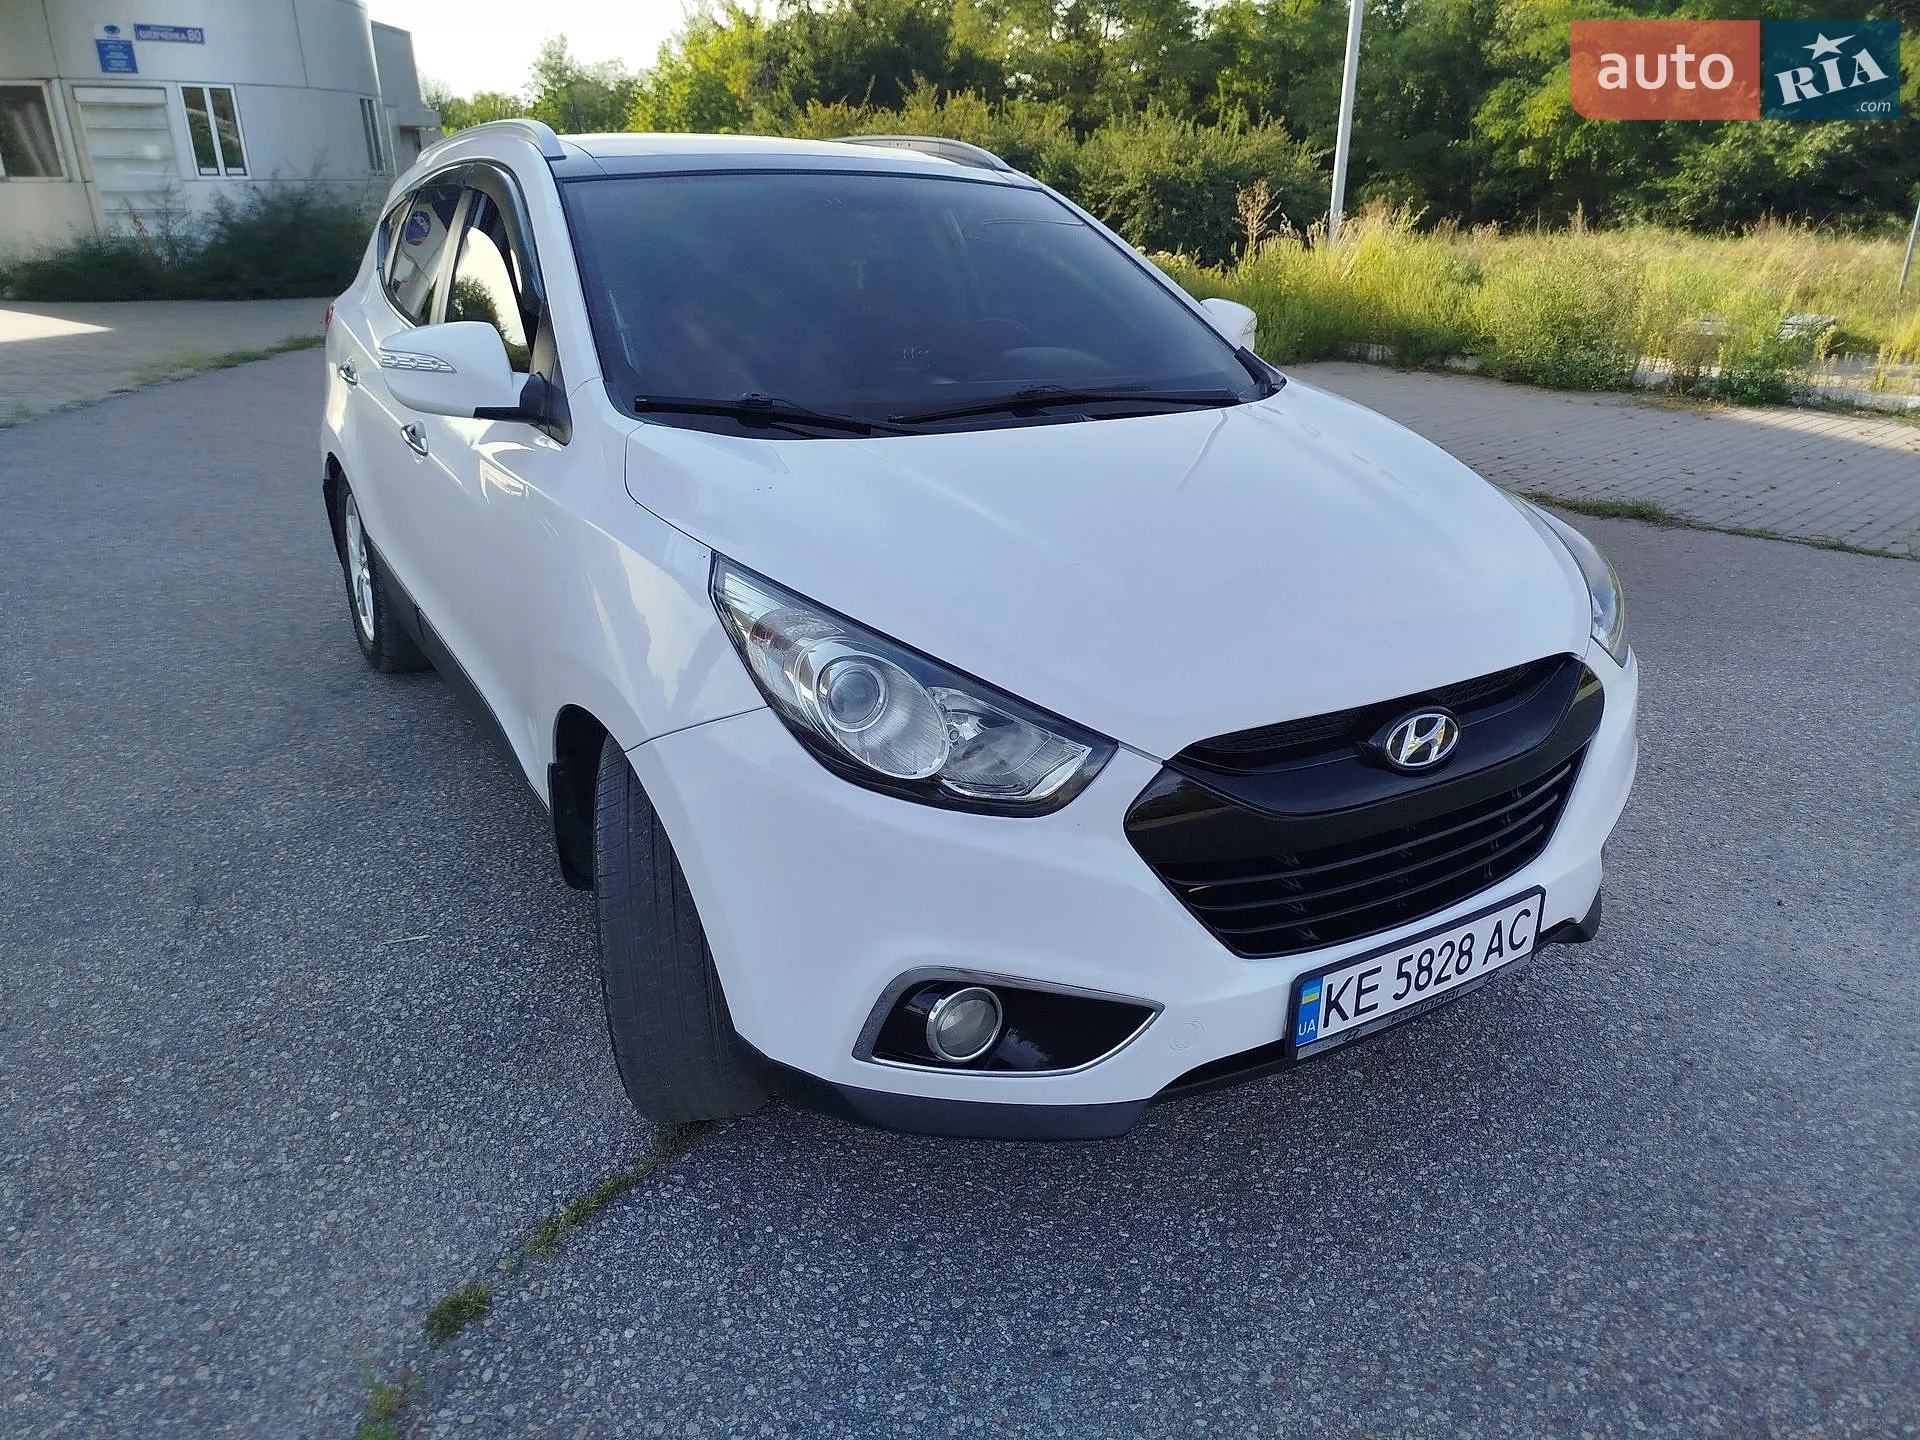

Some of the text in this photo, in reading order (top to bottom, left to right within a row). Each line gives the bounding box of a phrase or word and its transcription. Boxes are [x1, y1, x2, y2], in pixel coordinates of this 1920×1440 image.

[1322, 908, 1532, 1028] KE 5828 AC
[1298, 1019, 1316, 1036] UA
